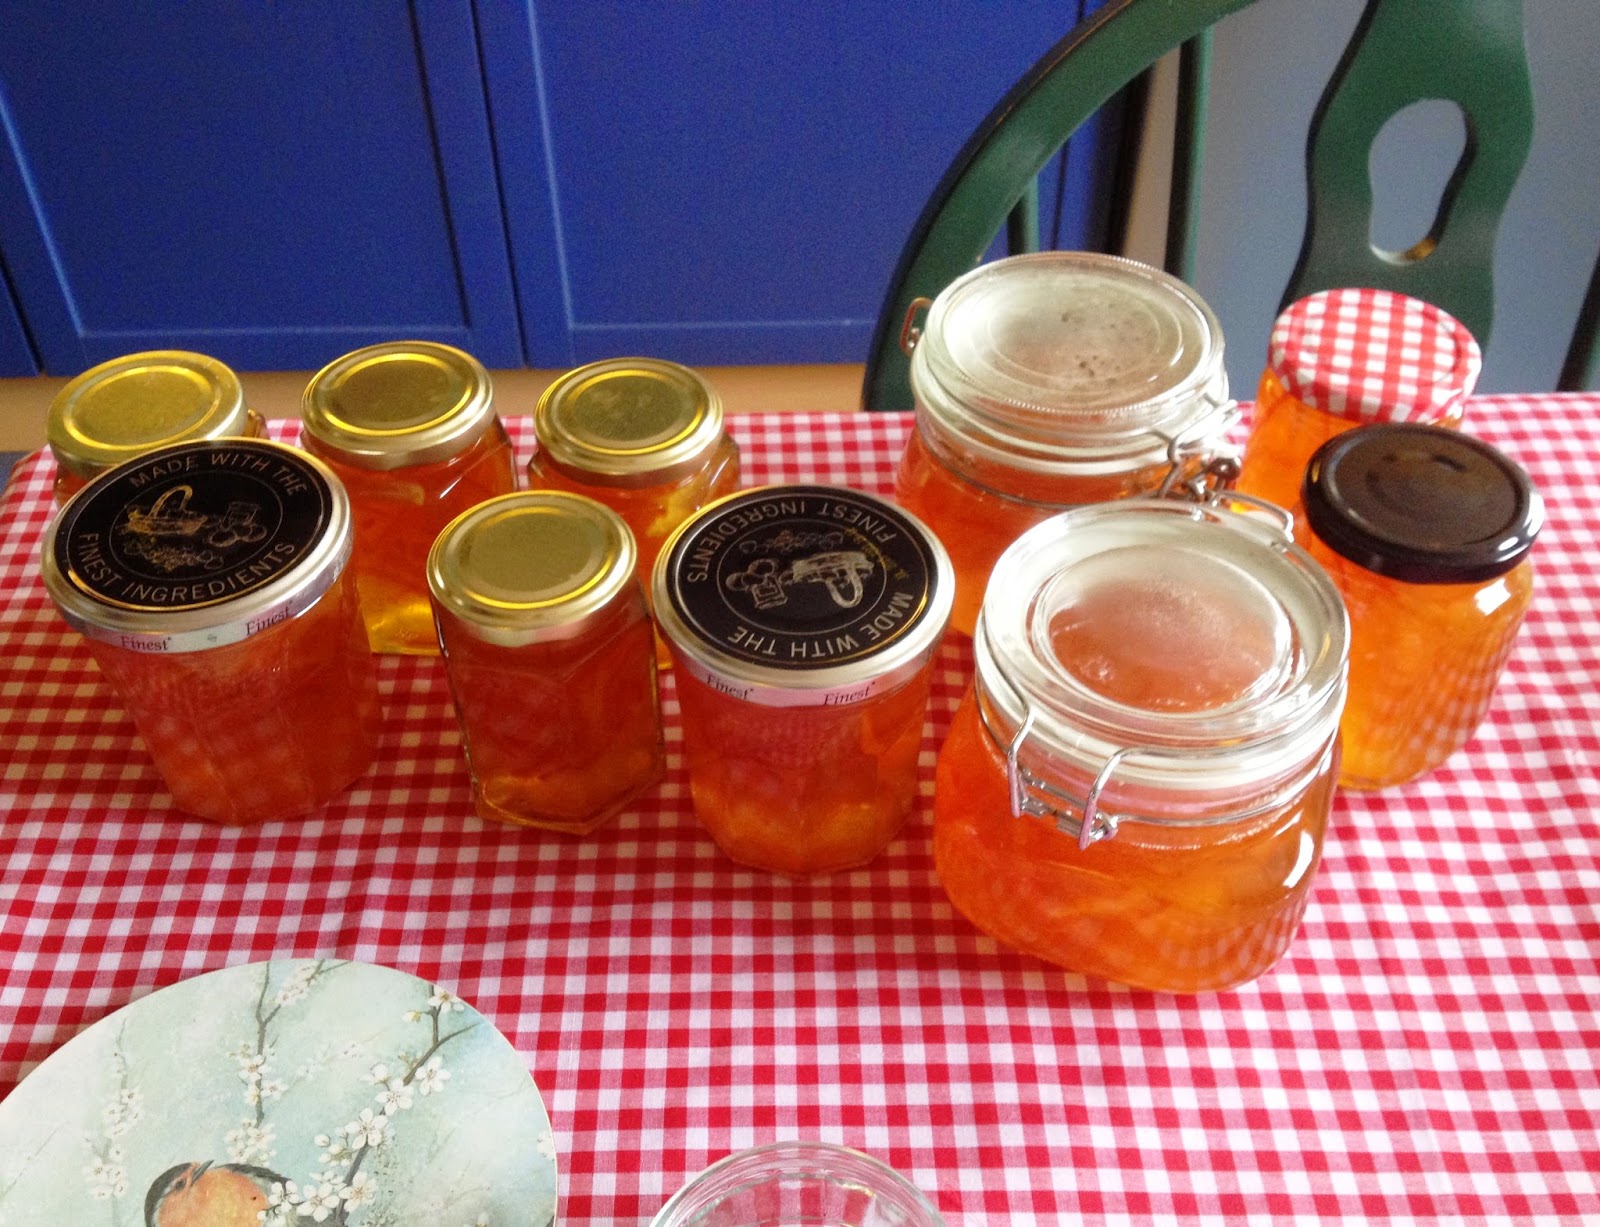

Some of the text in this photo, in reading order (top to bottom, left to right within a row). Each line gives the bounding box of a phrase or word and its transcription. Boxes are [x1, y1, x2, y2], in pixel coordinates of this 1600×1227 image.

[129, 453, 308, 496] MADE WITH THE
[80, 532, 295, 602] FINEST INGREDIENTS
[687, 501, 897, 582] FINEST INGREDIENTS
[727, 592, 914, 657] MADE WITH THE
